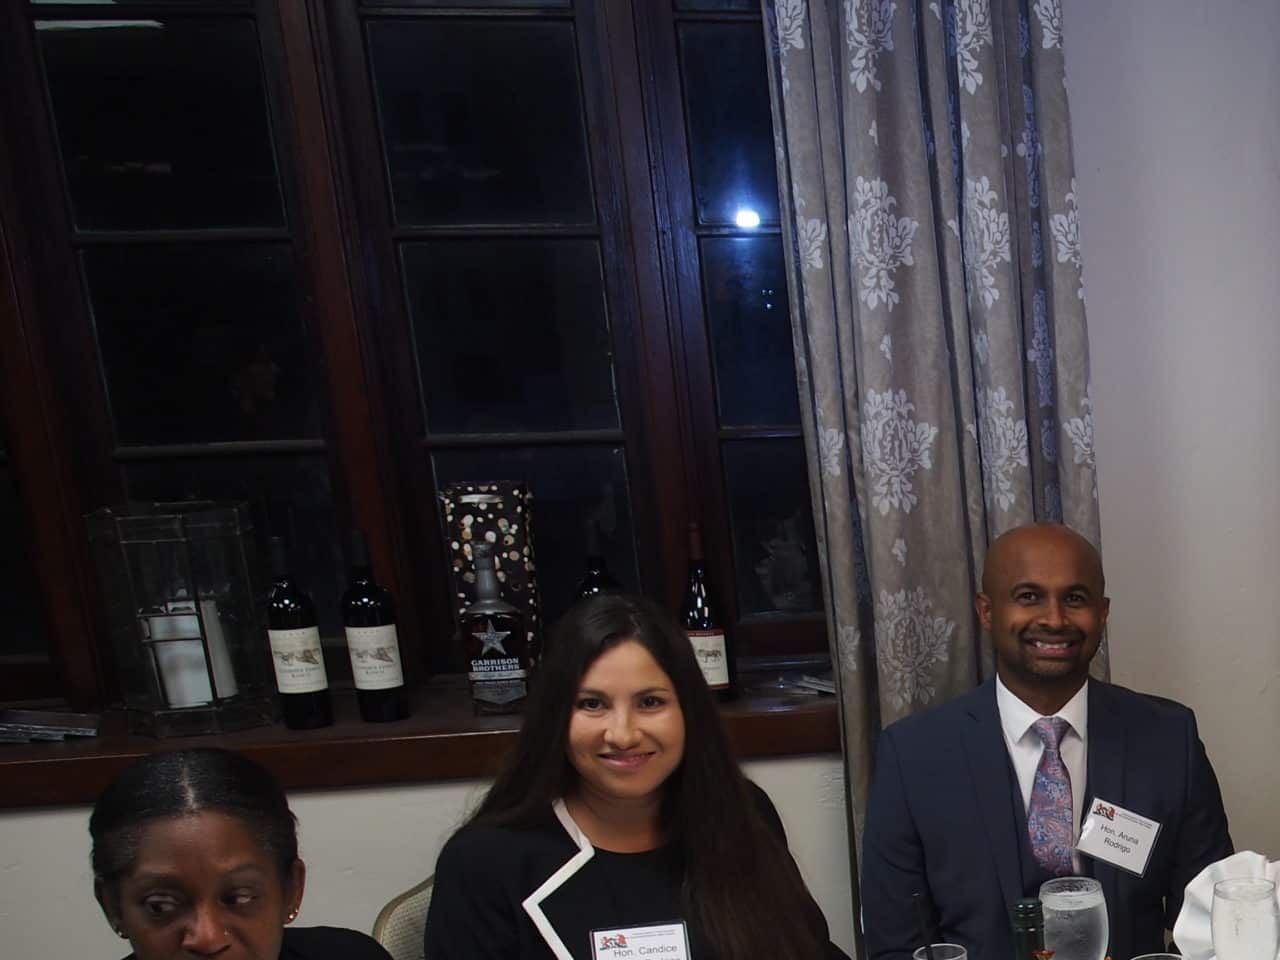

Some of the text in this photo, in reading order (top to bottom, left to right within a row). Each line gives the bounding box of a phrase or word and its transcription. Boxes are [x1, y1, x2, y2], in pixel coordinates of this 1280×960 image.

[471, 657, 519, 666] GARRISON
[472, 664, 520, 672] BROTHERS
[1104, 837, 1131, 853] Rodrigo
[639, 944, 678, 955] Candice
